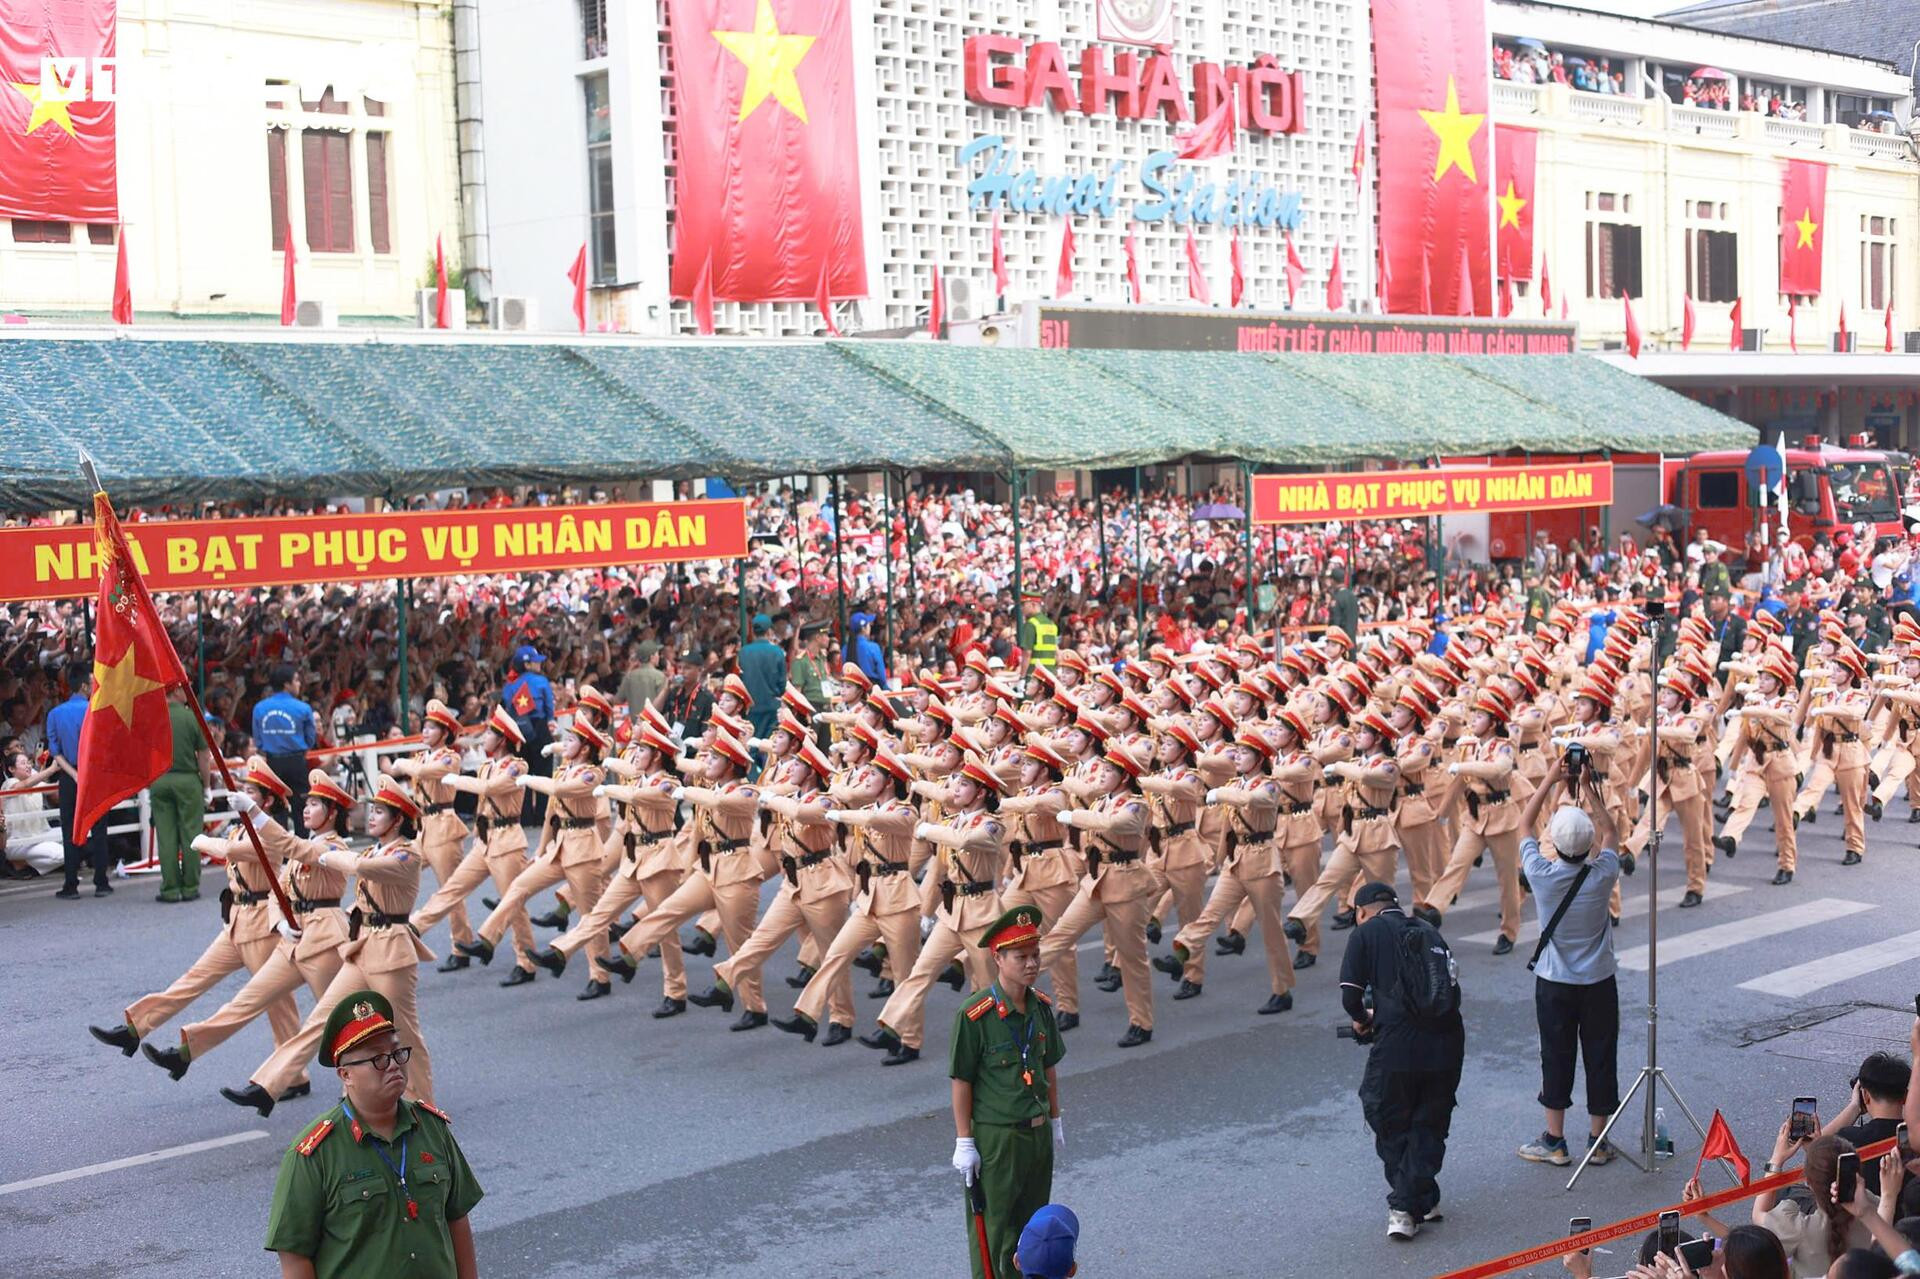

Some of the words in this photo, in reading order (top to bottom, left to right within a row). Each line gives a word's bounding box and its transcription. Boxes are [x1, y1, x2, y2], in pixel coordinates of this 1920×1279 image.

[963, 34, 1081, 112] GA
[1080, 43, 1191, 123] HÀ
[959, 134, 1124, 217] Hanoi
[1134, 151, 1303, 230] Station
[1328, 324, 1373, 354] CHÀO
[1448, 327, 1484, 354] NĂM
[1486, 328, 1525, 354] CÁCH
[1278, 480, 1330, 512] NHÀ
[1335, 483, 1380, 514] BẠT
[1386, 479, 1446, 510] PHỤC
[1452, 477, 1481, 508] VỤ
[1486, 472, 1545, 502] NHÂN
[1550, 469, 1593, 498] DÂN
[166, 534, 263, 580] BẠT
[279, 527, 408, 572] PHỤC
[421, 524, 479, 567] VỤ
[493, 514, 612, 557] NHÂN
[625, 509, 707, 550] DÂN
